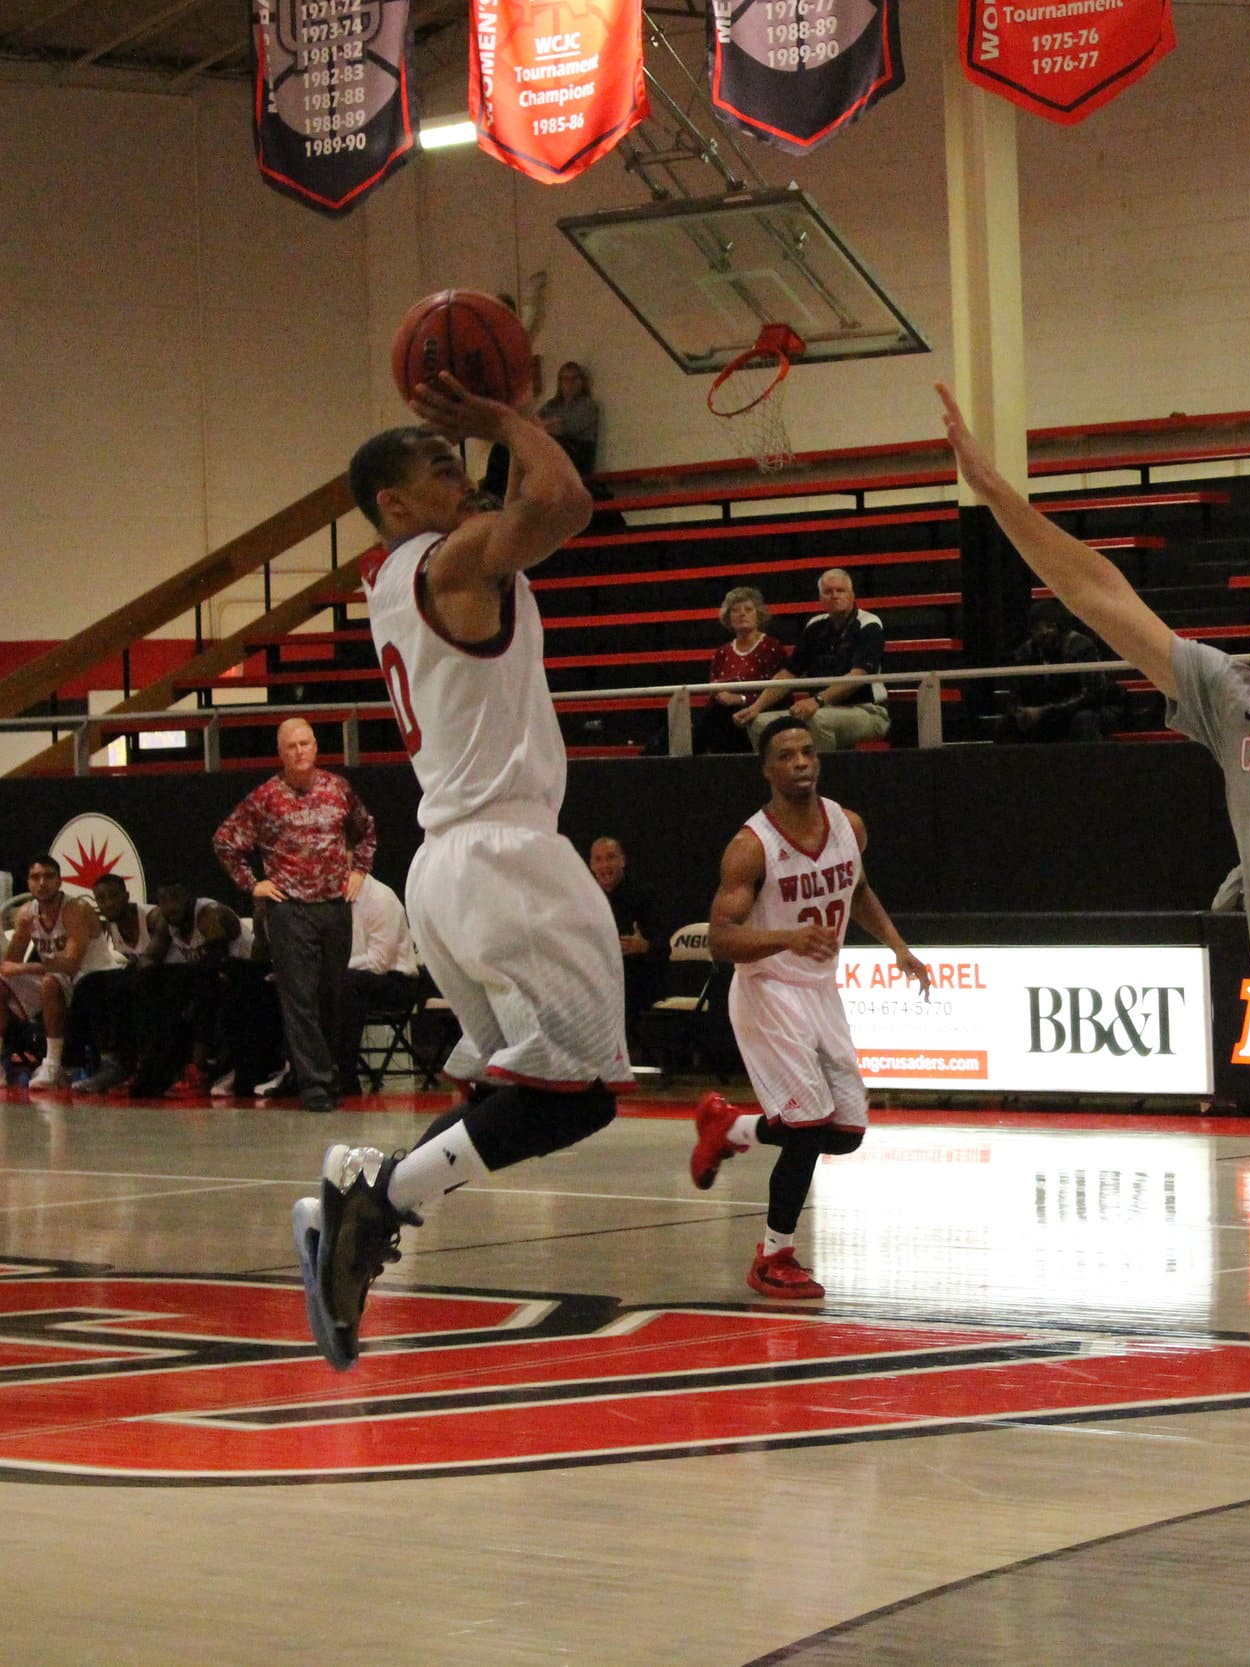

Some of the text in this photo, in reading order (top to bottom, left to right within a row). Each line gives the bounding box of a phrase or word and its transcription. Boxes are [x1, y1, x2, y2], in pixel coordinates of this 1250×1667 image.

[302, 17, 362, 43] 1973-74
[768, 16, 838, 44] 1988-89
[980, 0, 999, 61] WO
[1032, 28, 1099, 52] 1975-76
[303, 41, 363, 66] 1981-82
[535, 32, 580, 54] WCJC
[768, 40, 840, 67] 1989-90
[1032, 51, 1099, 75] 1976-77
[303, 64, 364, 89] 1982-83
[304, 87, 365, 111] 1987-88
[304, 110, 366, 134] 1988-89
[533, 113, 585, 136] 1985-86
[305, 133, 366, 157] 1989-90
[778, 860, 854, 902] WOLVES
[1025, 984, 1186, 1057] BB&T
